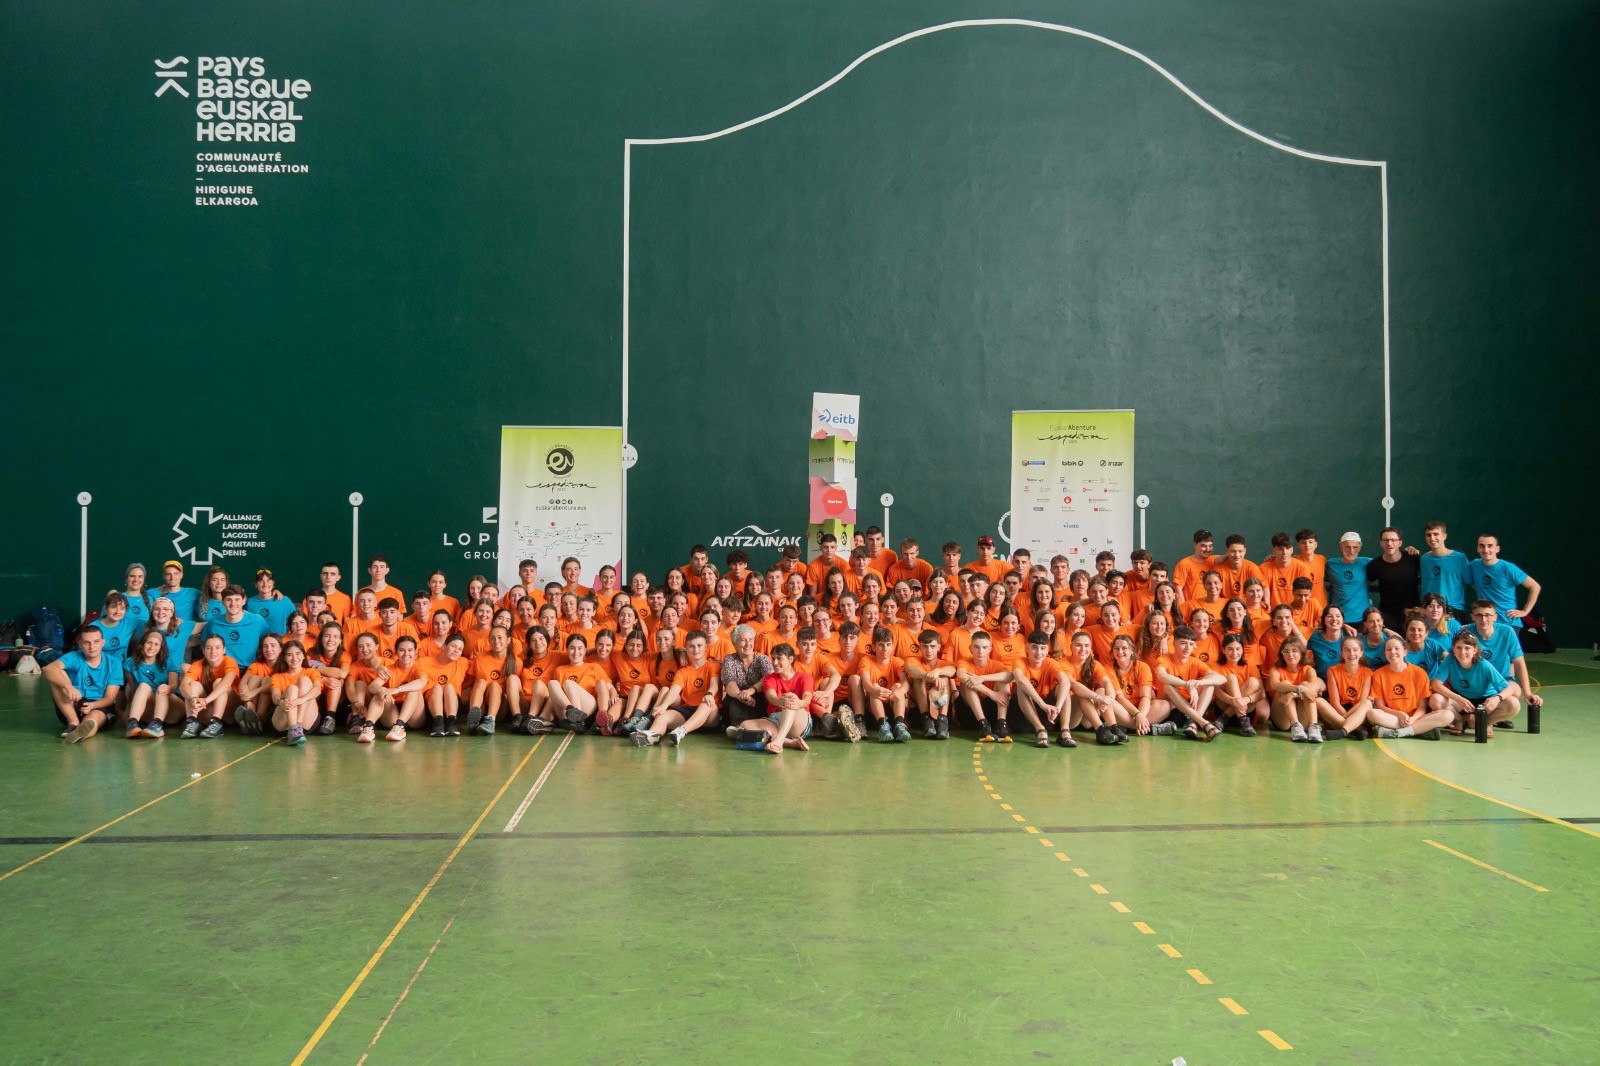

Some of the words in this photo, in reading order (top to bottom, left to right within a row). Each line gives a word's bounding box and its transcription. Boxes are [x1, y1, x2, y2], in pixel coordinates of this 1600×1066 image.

[196, 152, 282, 162] COMMUNAUTÉ
[195, 186, 254, 194] HIRIGUNE
[195, 197, 259, 206] ELKARGOA
[832, 413, 856, 425] eitb
[443, 532, 499, 546] LOP
[711, 536, 802, 547] ARTZAINAK
[463, 551, 499, 560] GROU
